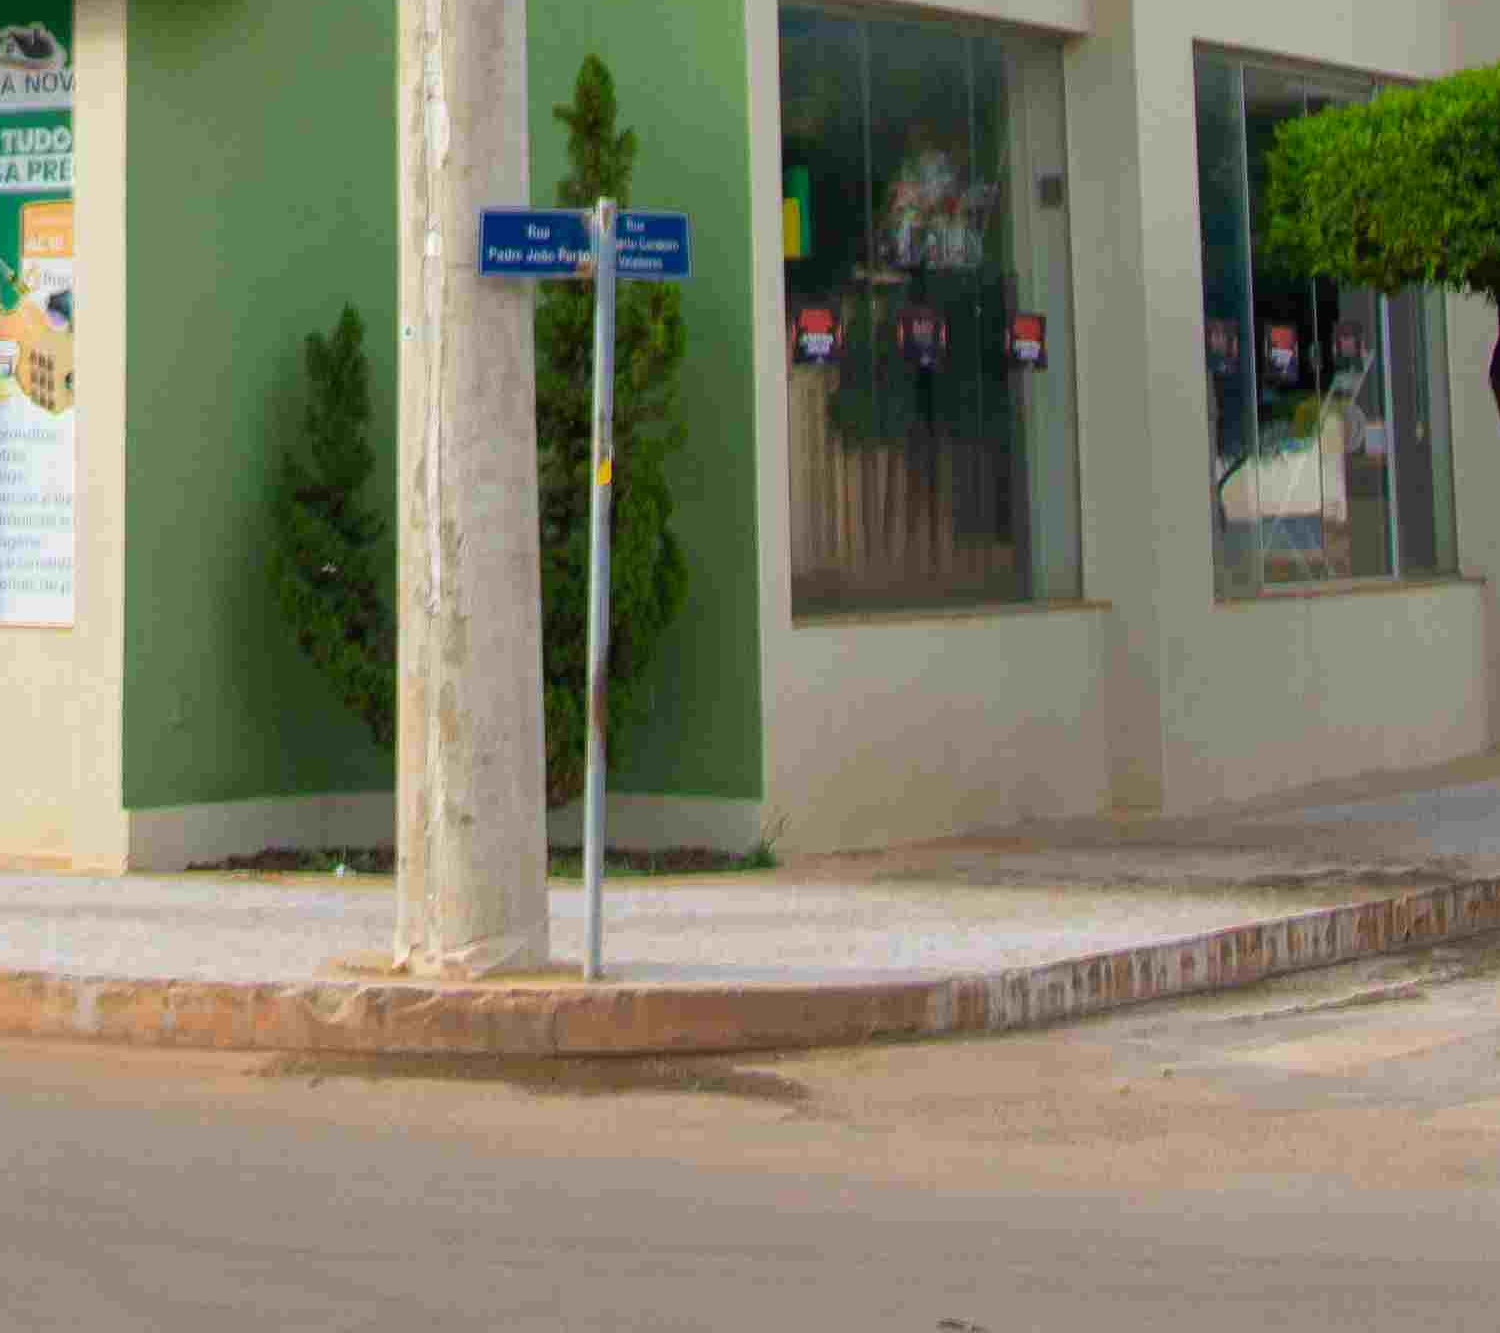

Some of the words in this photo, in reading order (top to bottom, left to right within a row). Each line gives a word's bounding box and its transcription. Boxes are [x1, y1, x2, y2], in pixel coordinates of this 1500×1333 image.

[25, 67, 76, 94] NOV
[1, 125, 73, 155] TUDO
[528, 222, 551, 240] Rua
